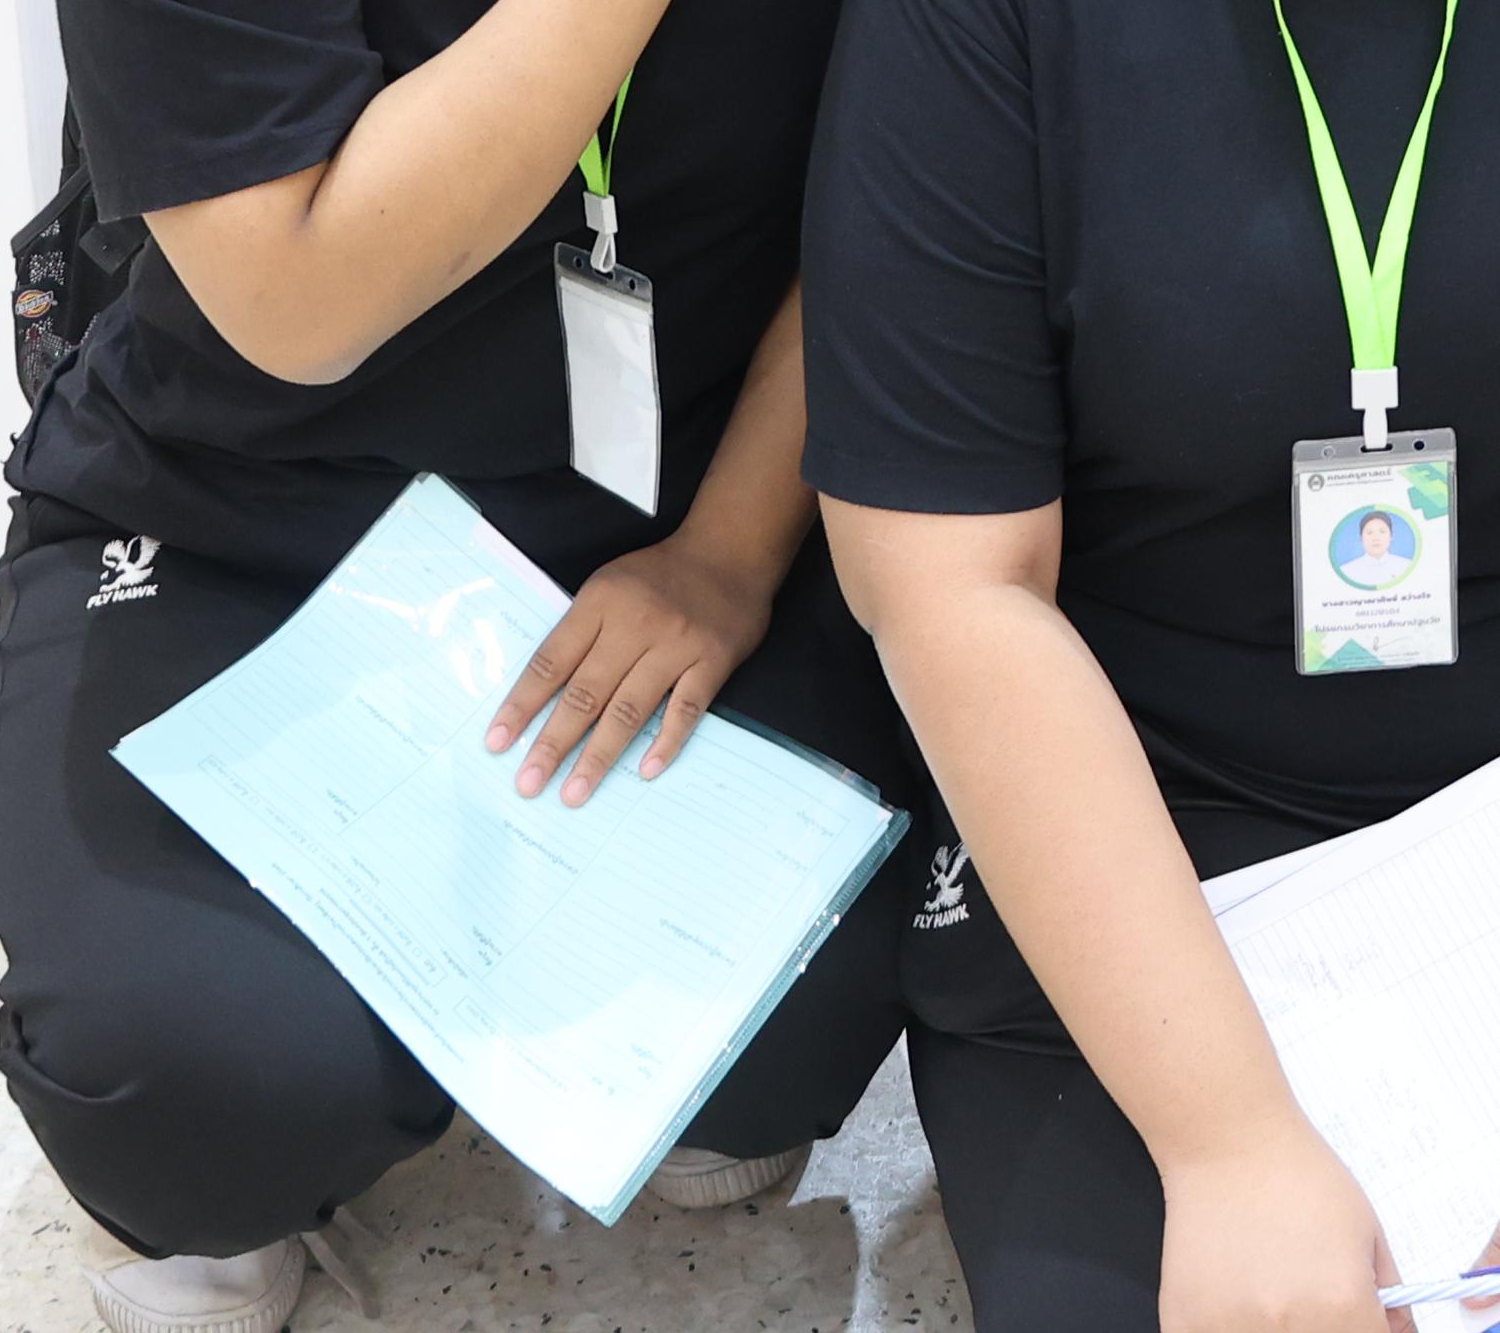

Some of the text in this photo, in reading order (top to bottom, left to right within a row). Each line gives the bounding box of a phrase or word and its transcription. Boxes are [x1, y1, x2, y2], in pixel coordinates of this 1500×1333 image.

[86, 584, 159, 610] FLY HAWK
[912, 903, 970, 929] FLY HAWK
